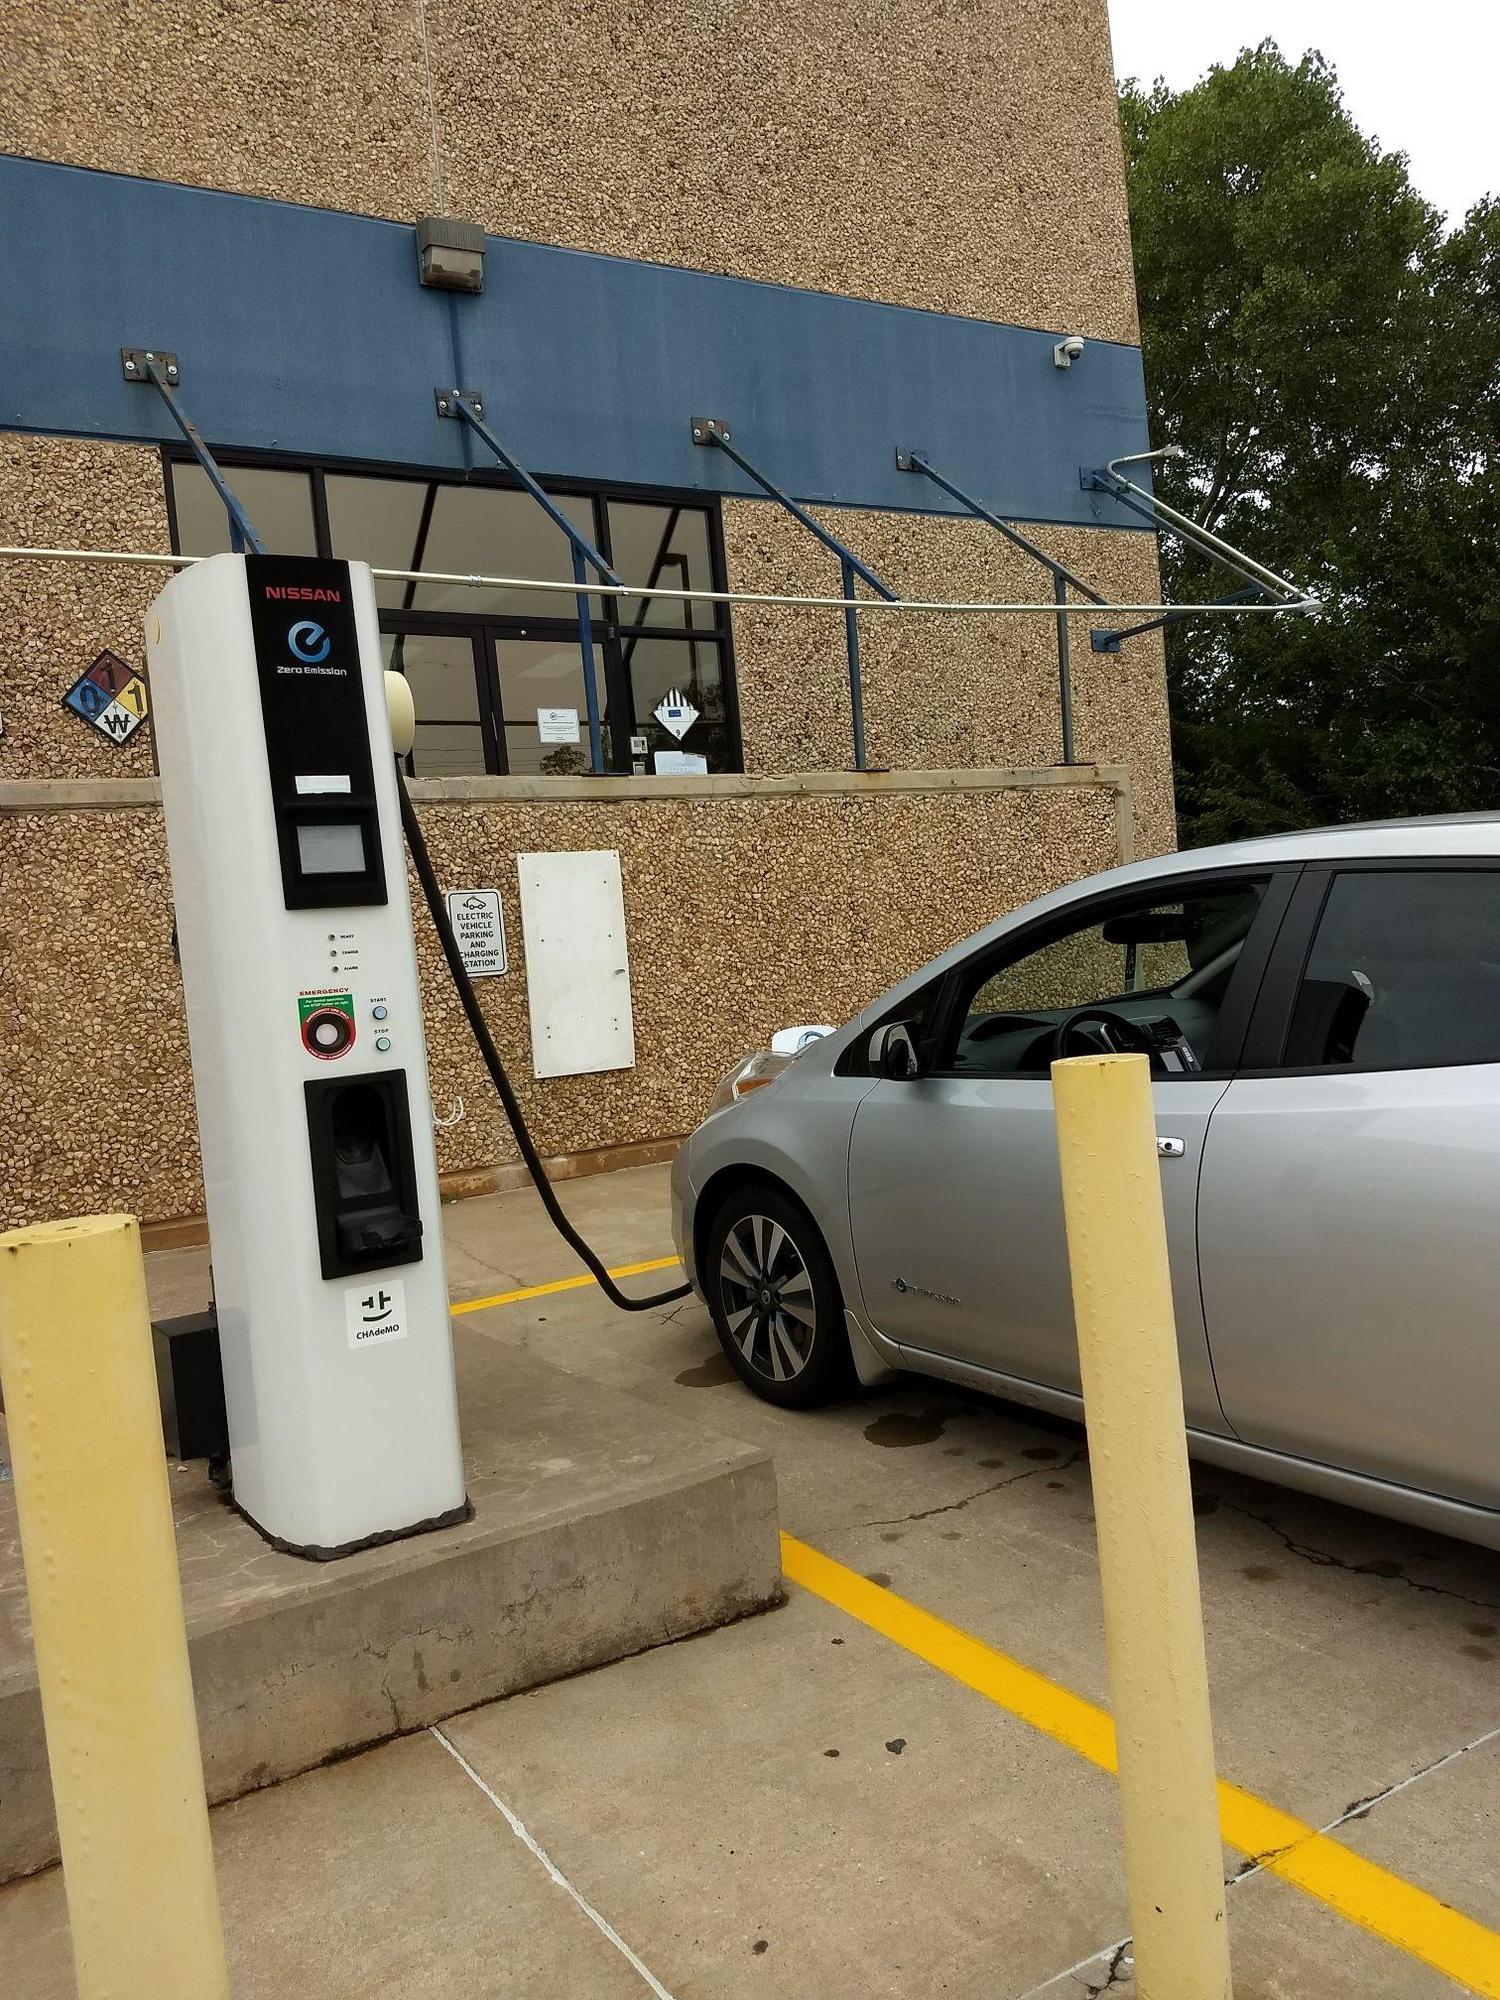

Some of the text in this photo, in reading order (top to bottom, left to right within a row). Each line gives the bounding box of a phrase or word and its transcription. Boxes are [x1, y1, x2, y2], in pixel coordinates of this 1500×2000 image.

[266, 586, 340, 602] NISSAN
[277, 666, 347, 676] Zero Emission
[80, 685, 100, 714] 0
[128, 685, 145, 713] 1
[457, 912, 494, 921] ELECTRIC
[460, 921, 492, 930] VEHICLE
[460, 931, 494, 940] PARKING
[470, 941, 486, 949] AND
[464, 959, 496, 968] STATION
[299, 987, 349, 996] EMERGENCY
[356, 1324, 400, 1340] CHAdeMO
